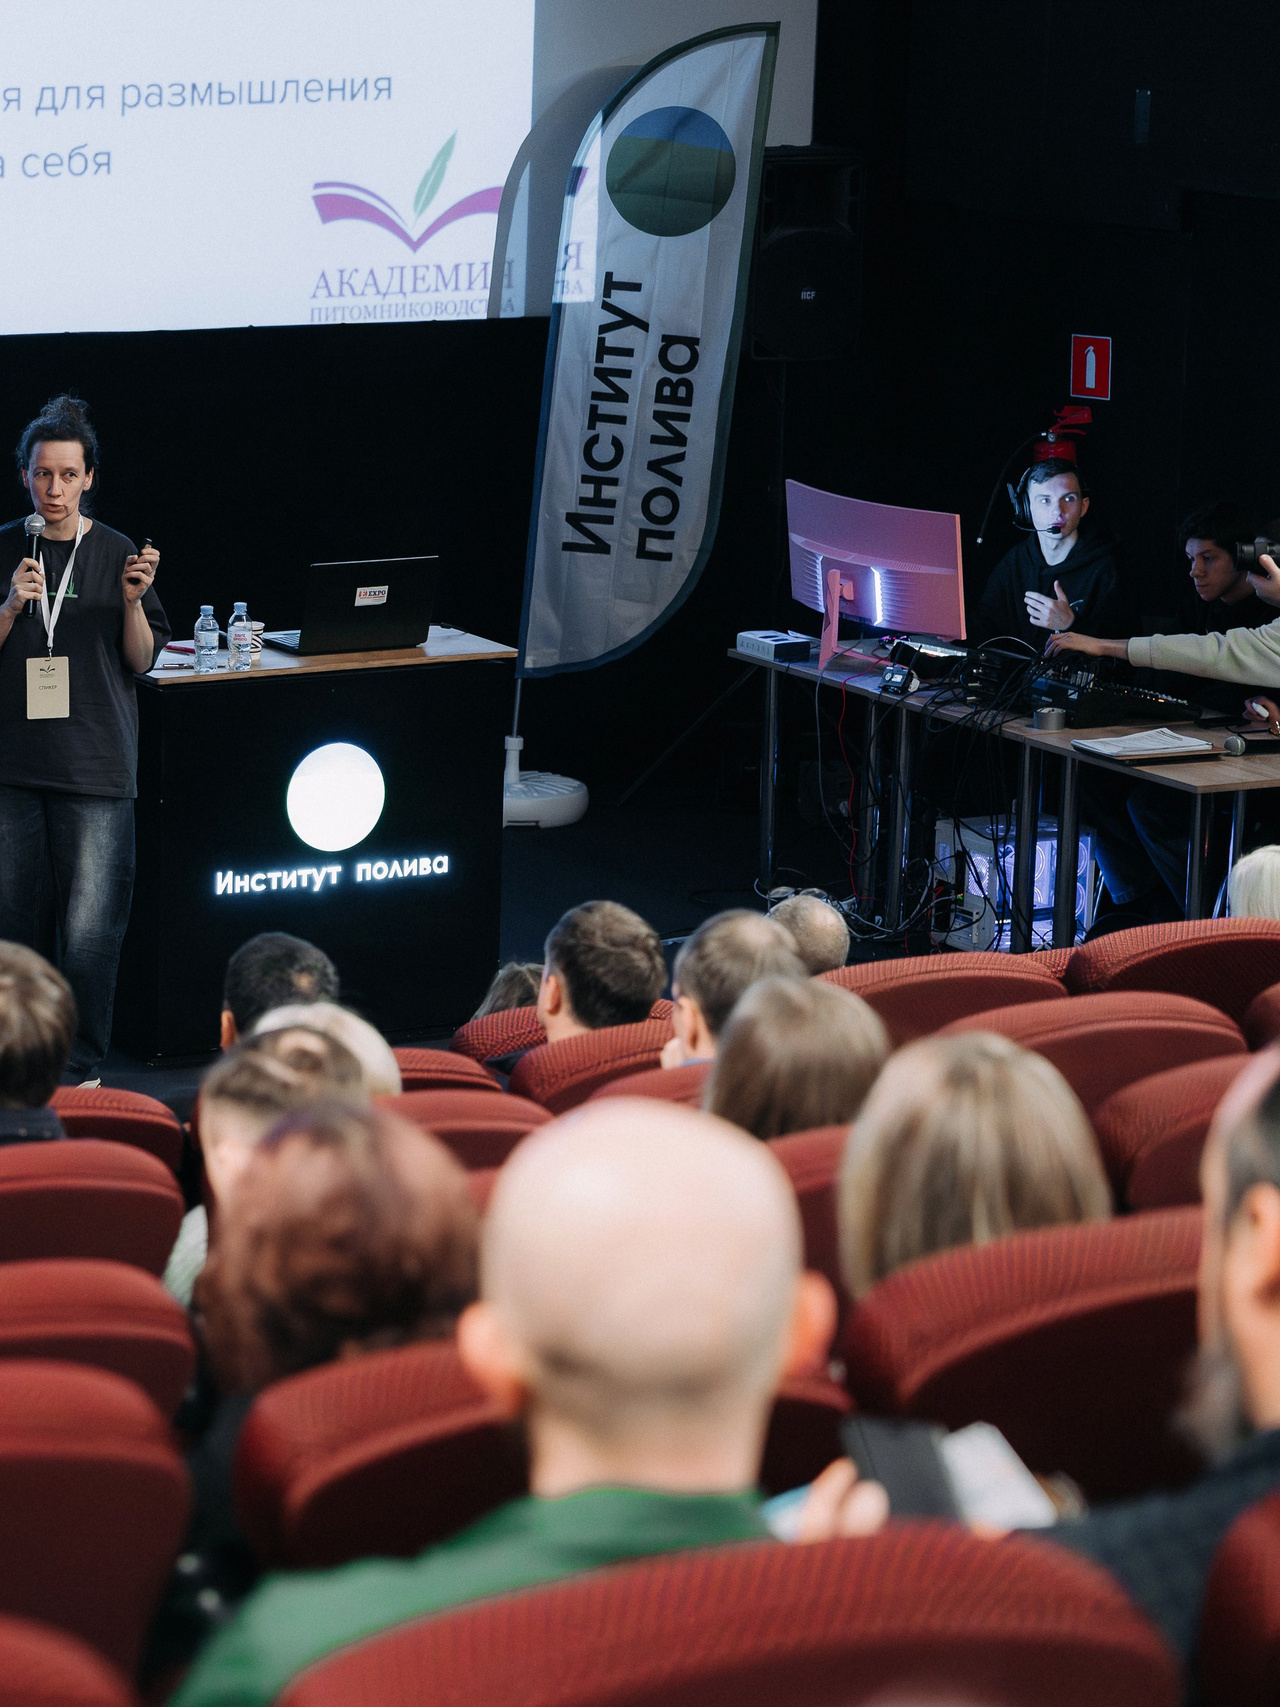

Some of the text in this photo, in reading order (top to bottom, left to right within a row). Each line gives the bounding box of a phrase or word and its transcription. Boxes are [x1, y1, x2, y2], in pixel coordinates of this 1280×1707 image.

[35, 85, 106, 116] для
[121, 76, 393, 117] размышления
[21, 143, 112, 178] себя
[562, 271, 650, 556] Институт
[635, 334, 701, 562] полива
[215, 854, 450, 896] Институт полива
